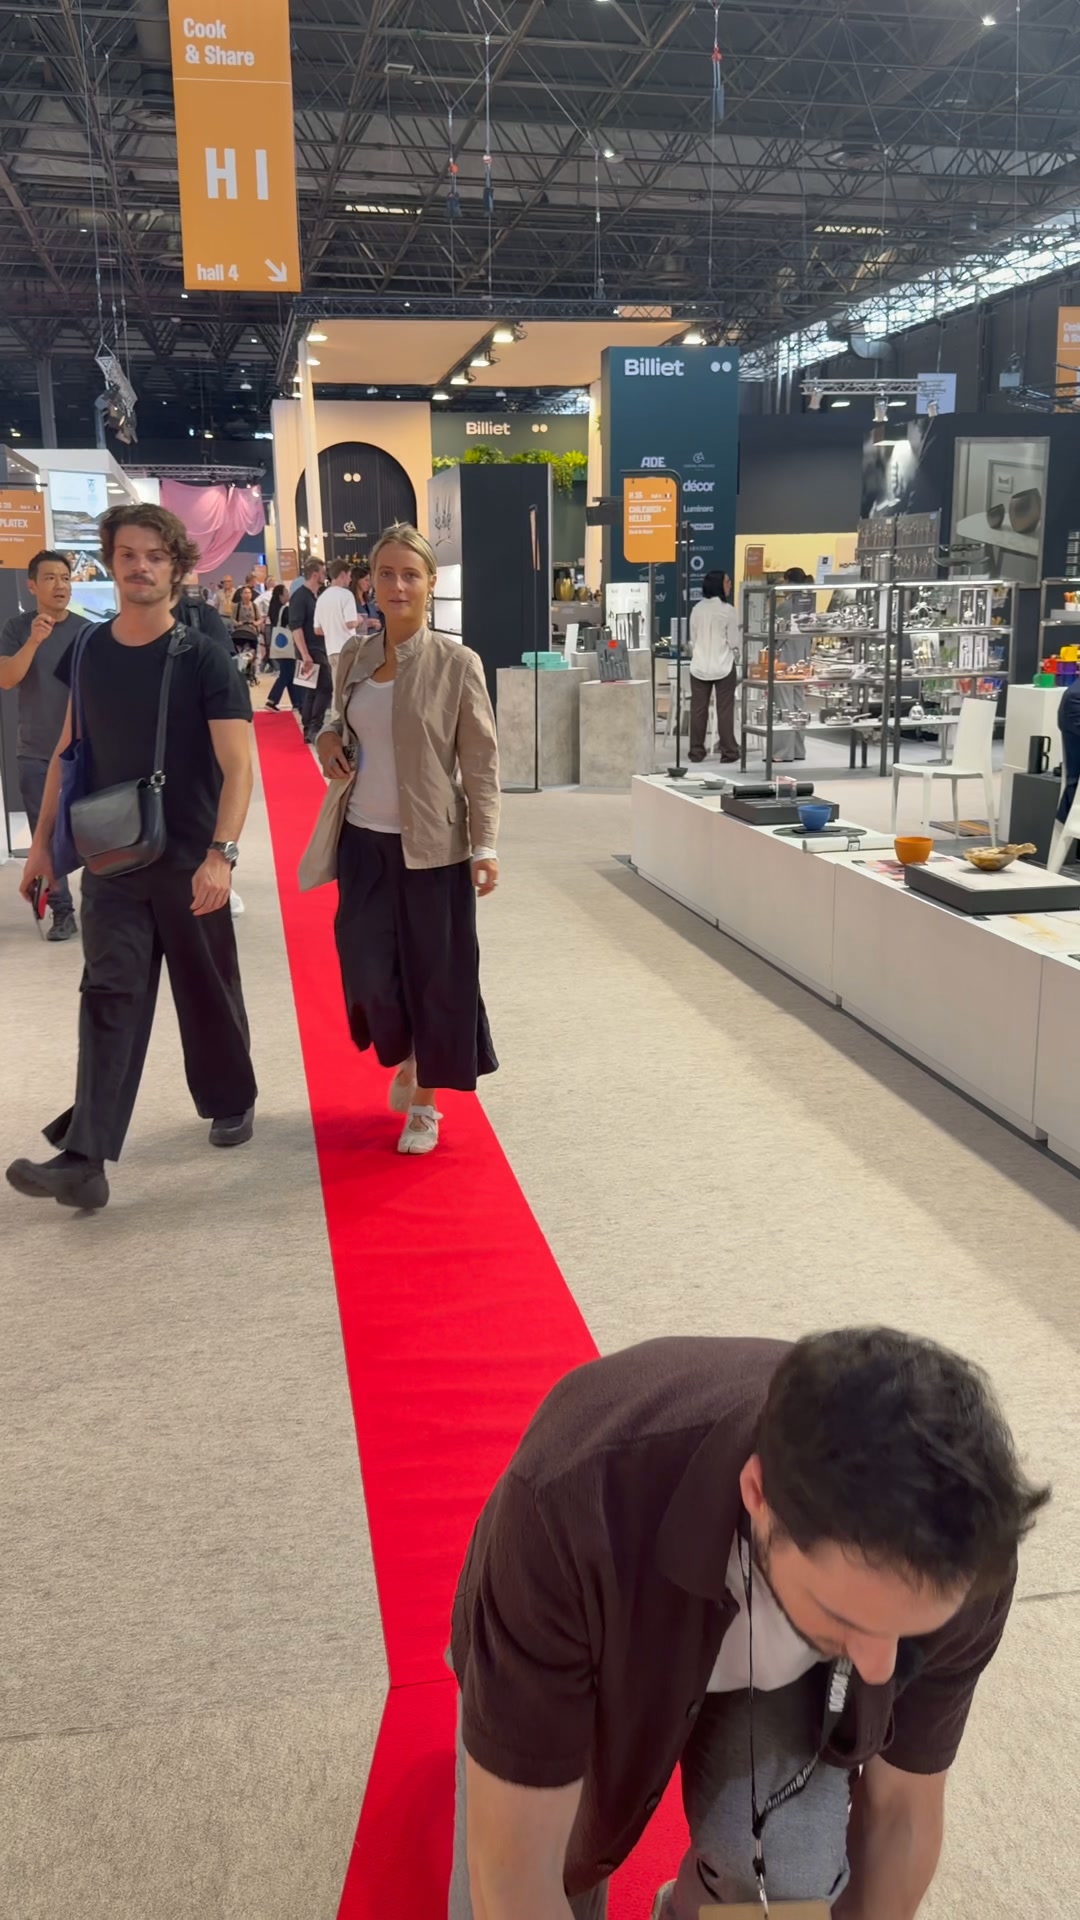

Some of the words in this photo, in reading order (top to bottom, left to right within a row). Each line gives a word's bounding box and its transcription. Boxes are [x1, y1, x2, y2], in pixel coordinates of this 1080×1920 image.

[183, 18, 227, 39] Cook
[185, 45, 200, 64] &
[204, 46, 255, 66] Share
[205, 148, 238, 199] H
[197, 264, 225, 281] hall
[227, 264, 239, 281] 4
[624, 357, 684, 376] Billiet
[466, 421, 511, 436] Billiet
[641, 456, 667, 468] ADE
[682, 479, 715, 492] décor
